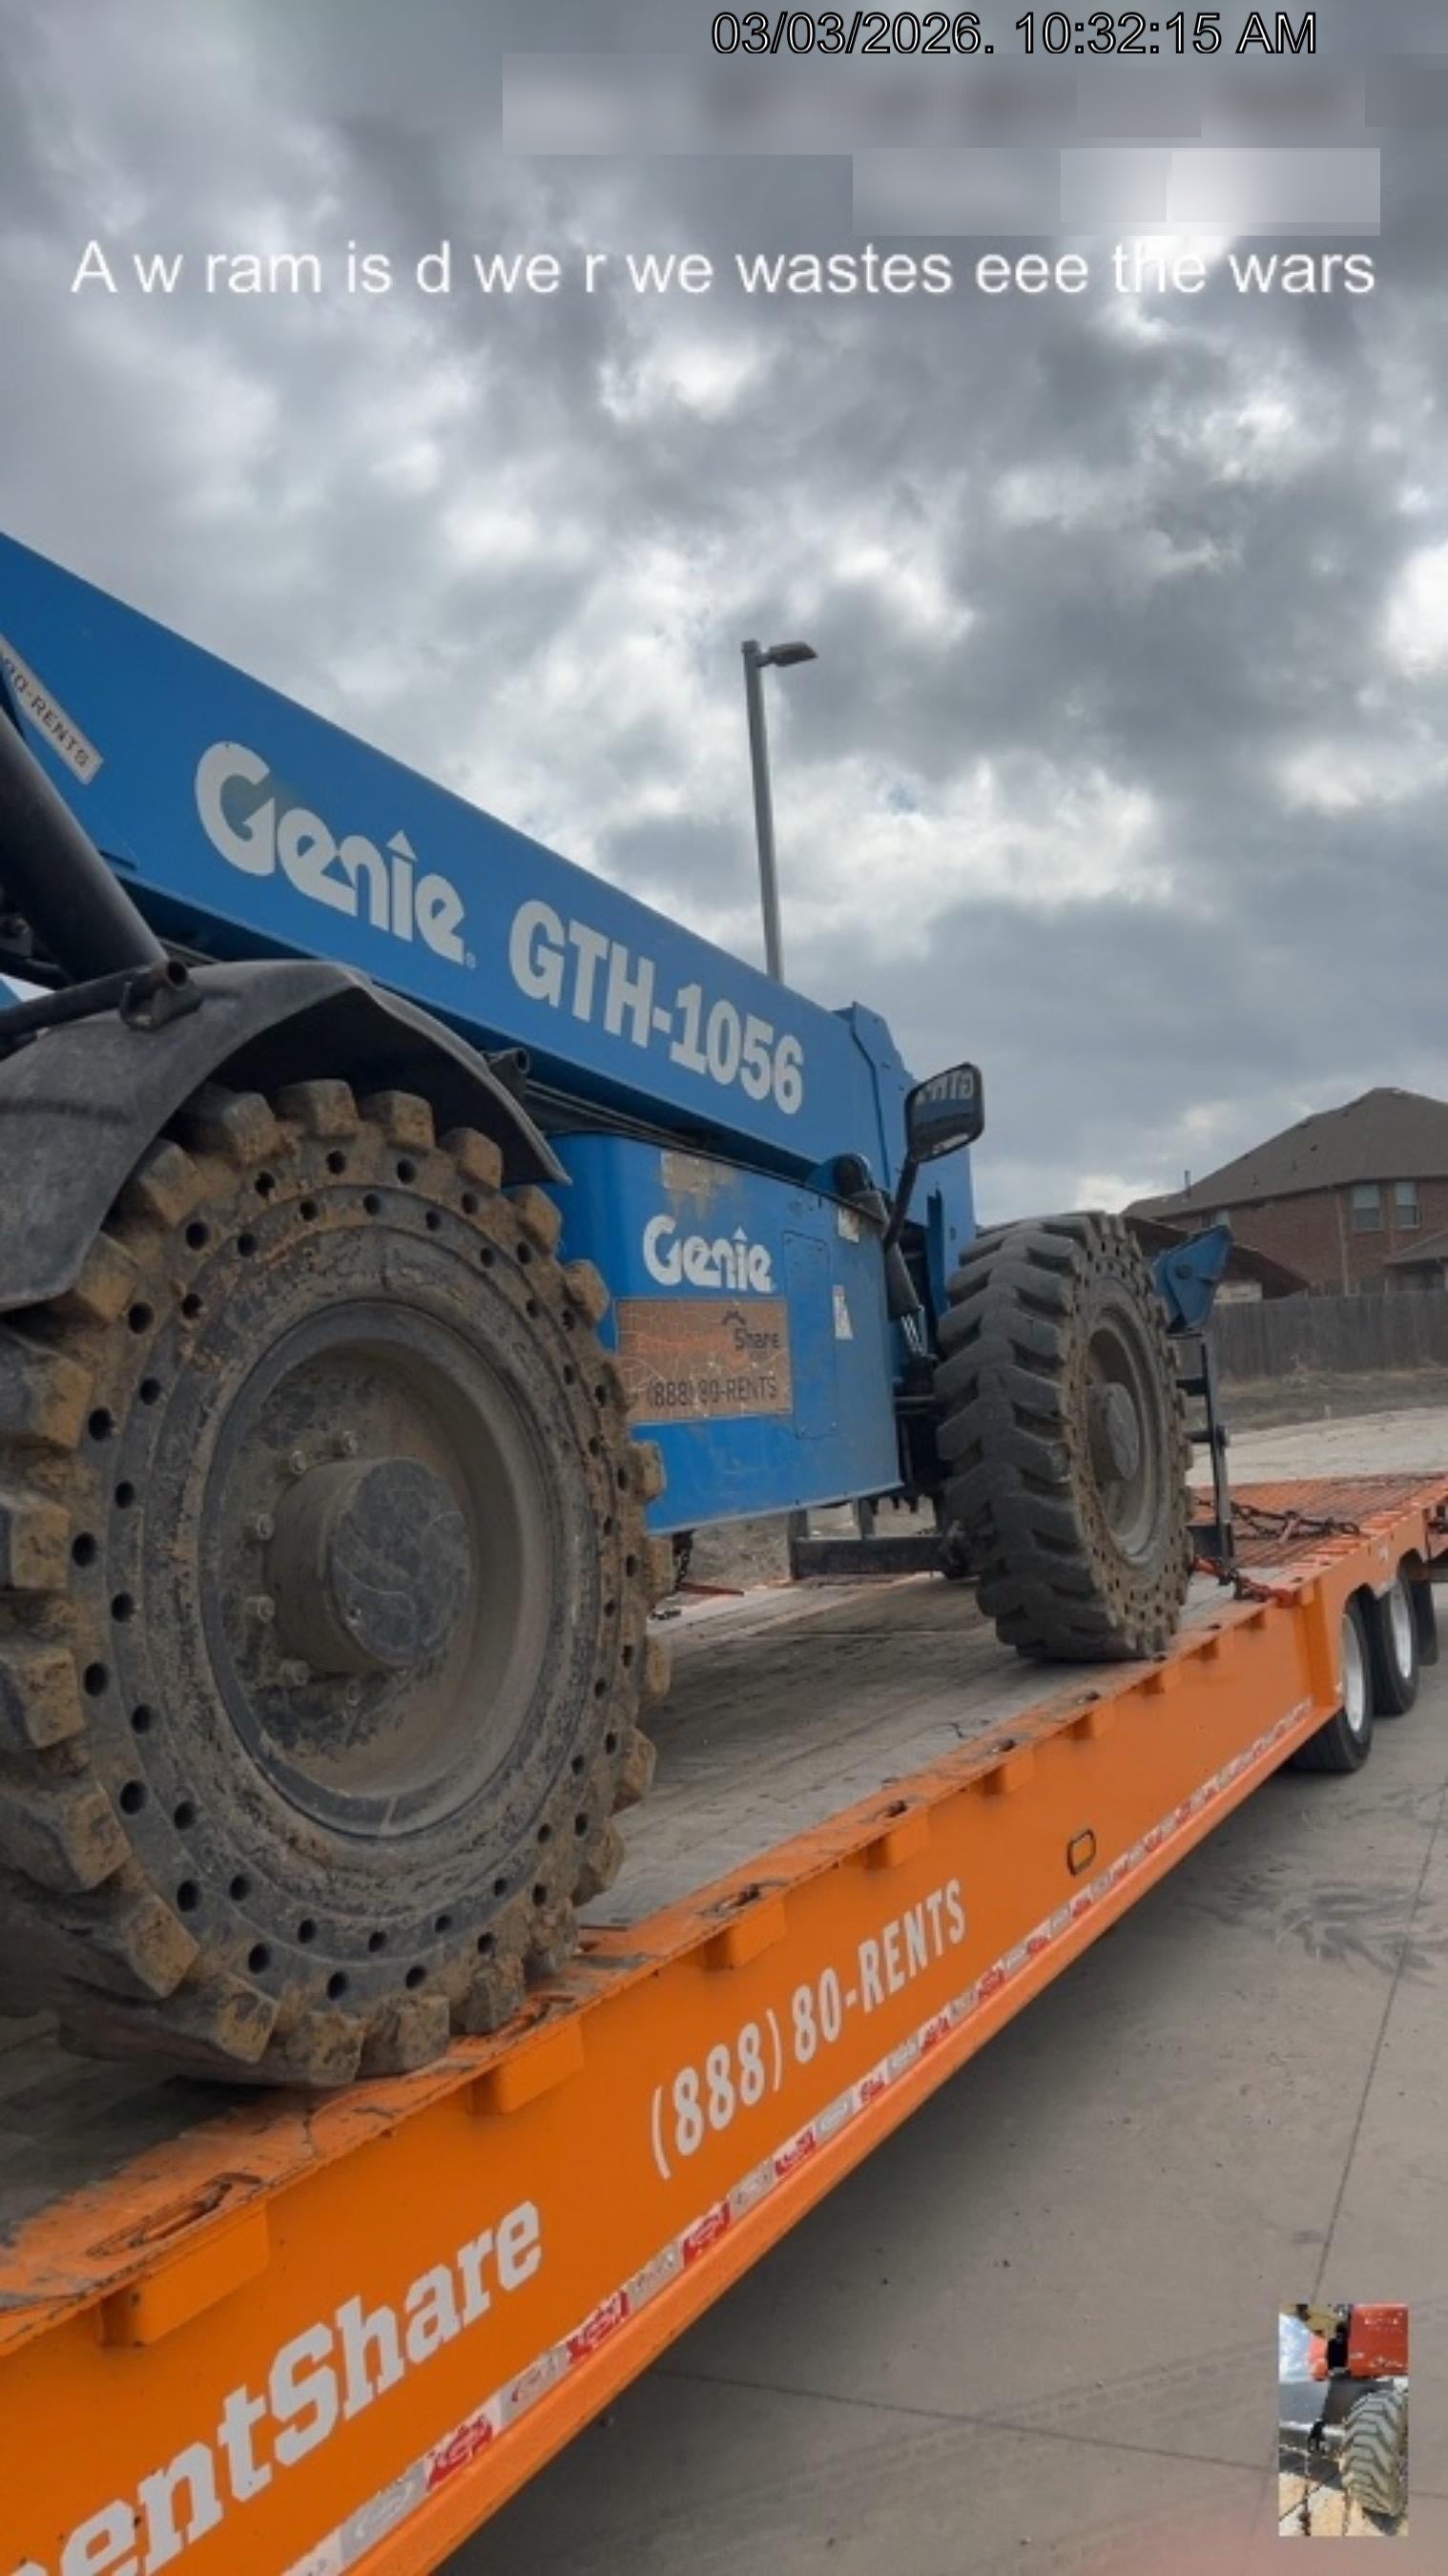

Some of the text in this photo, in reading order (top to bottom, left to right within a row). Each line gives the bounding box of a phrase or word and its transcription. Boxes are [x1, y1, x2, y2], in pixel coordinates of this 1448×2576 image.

[195, 741, 806, 1115] Genie GTH-1056
[643, 1215, 774, 1294] Genie
[651, 1878, 966, 2180] (888) 80-RENTS
[0, 2200, 543, 2576] entShare
